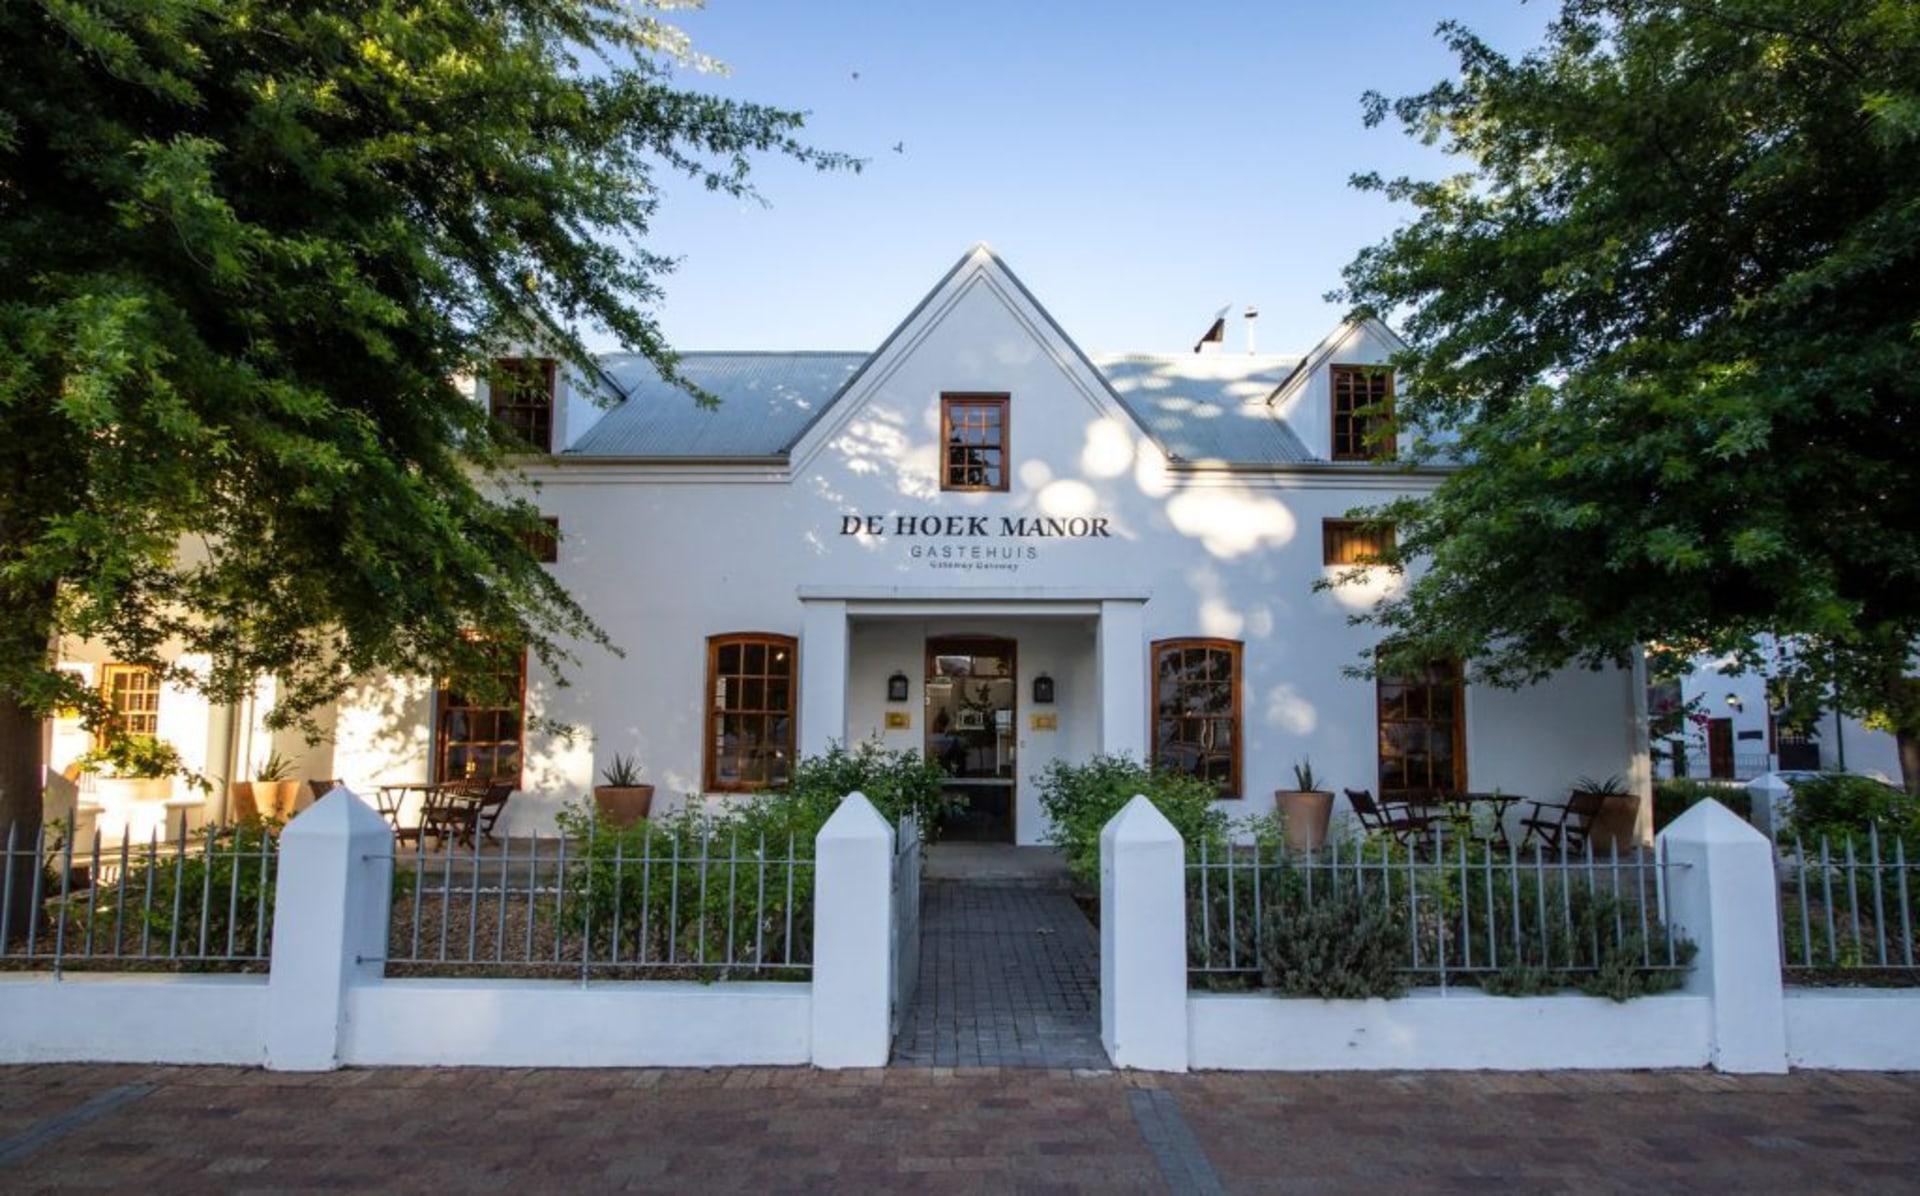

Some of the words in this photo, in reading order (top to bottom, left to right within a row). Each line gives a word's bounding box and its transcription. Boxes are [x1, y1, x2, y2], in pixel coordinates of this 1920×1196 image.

[839, 514, 884, 536] DE
[894, 515, 990, 537] HOEK
[999, 516, 1112, 538] MANOR
[910, 544, 1038, 560] GASTEHUIS
